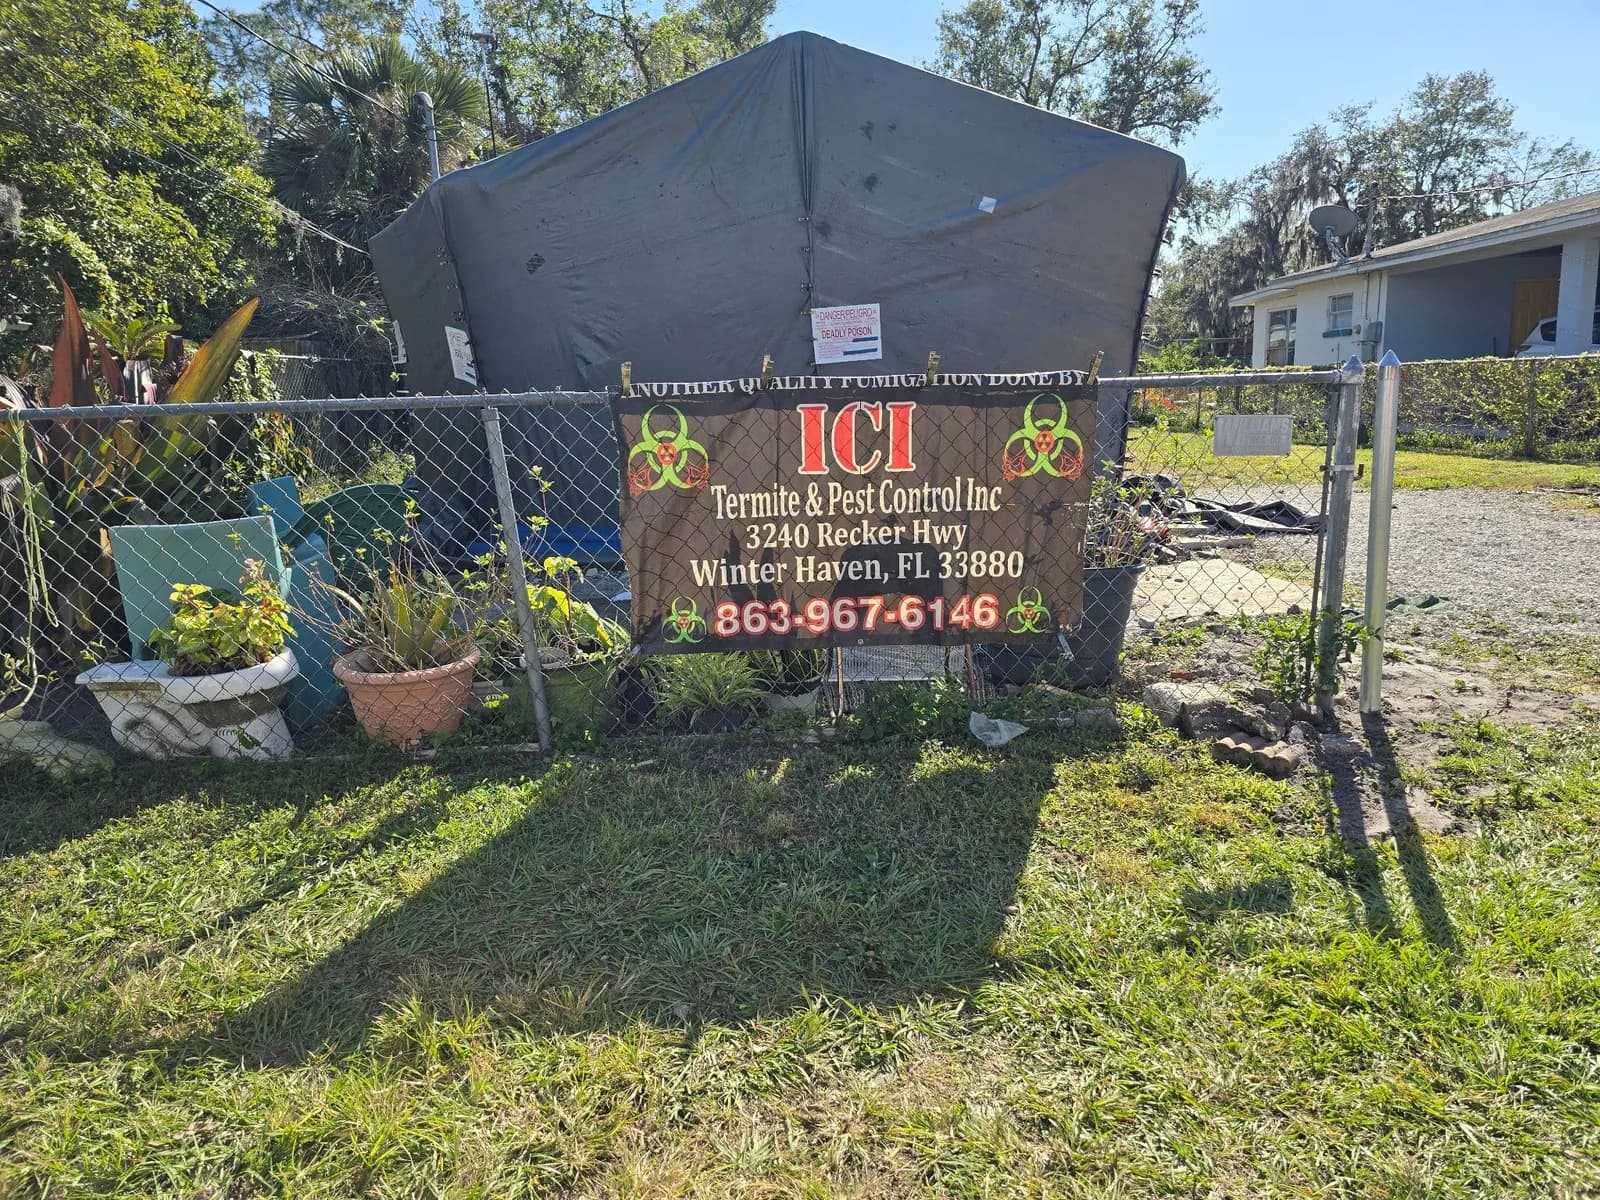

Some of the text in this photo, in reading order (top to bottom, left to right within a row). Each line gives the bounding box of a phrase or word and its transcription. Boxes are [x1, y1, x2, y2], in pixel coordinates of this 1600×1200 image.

[821, 326, 873, 339] DEADLY POISON
[739, 376, 834, 395] QUALITY
[989, 372, 1053, 386] DONE
[1059, 370, 1086, 386] BY
[796, 401, 916, 474] ICI
[711, 477, 1003, 520] Termite & Pest Control Inc
[745, 519, 968, 550] 3240 Recker Hwy
[690, 550, 1024, 587] Winter Haven, FL 33880
[714, 594, 1000, 637] 863-967-6146
